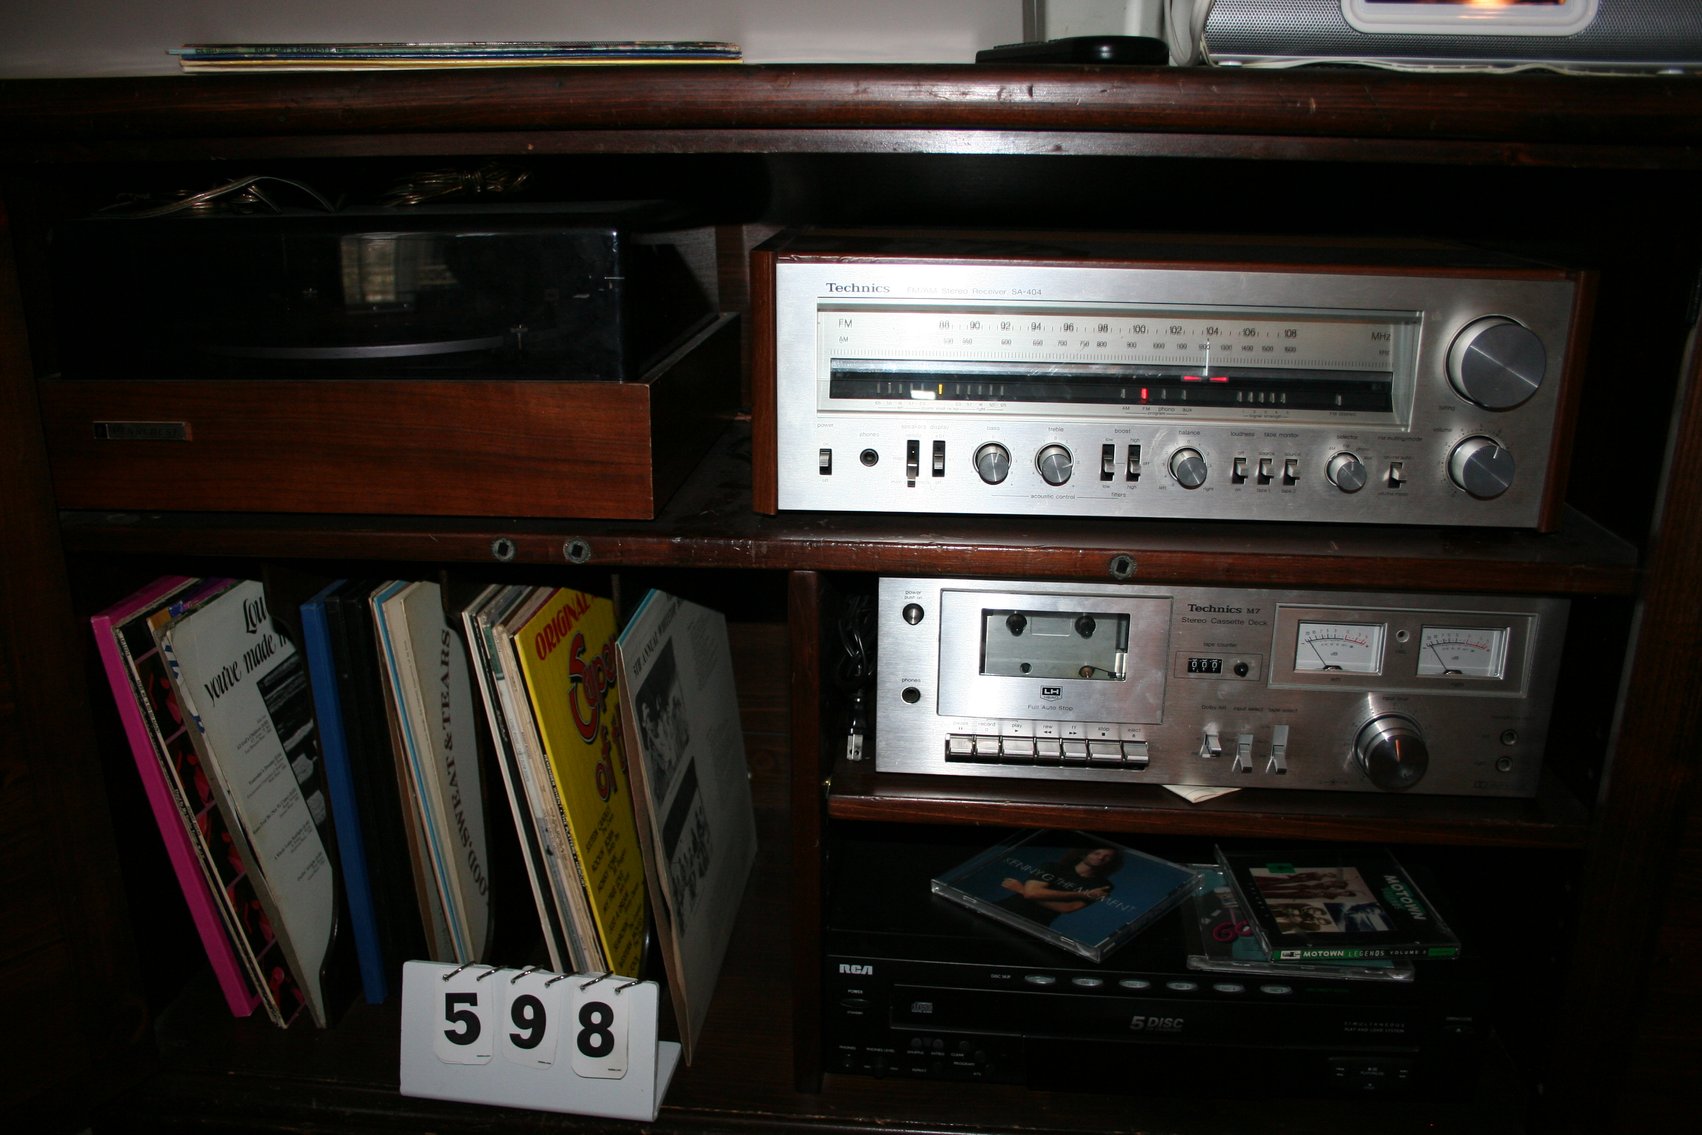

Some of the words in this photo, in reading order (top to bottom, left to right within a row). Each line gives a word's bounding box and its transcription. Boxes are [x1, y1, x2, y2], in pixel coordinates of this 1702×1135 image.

[825, 282, 890, 294] Technics
[941, 287, 968, 295] Stereo
[972, 288, 1007, 296] Receiver
[1011, 288, 1042, 296] SA-404
[838, 318, 852, 328] FM
[969, 321, 980, 330] 90
[1000, 321, 1011, 331] 92
[1030, 322, 1042, 331] 94
[1063, 322, 1074, 332] 96
[1098, 323, 1109, 333] 98
[1133, 325, 1146, 335] 100
[1169, 326, 1182, 335] 102
[1206, 326, 1219, 336] 104
[1242, 327, 1256, 337] 106
[1284, 328, 1297, 338] 108
[1371, 332, 1391, 341] MHz
[859, 431, 880, 439] phones
[243, 596, 267, 634] Lou
[1188, 604, 1242, 615] Technics
[1181, 616, 1208, 624] Stereo
[1210, 617, 1245, 626] Cassette
[1248, 618, 1268, 626] Deck
[243, 633, 277, 674] made
[1191, 661, 1218, 669] 000
[440, 628, 451, 730] TEARS
[443, 731, 453, 752] &
[445, 755, 470, 848] SWEAT
[1005, 857, 1045, 875] KENNY
[1042, 873, 1056, 882] G
[1384, 875, 1427, 920] MOTOWN
[839, 963, 874, 976] RCA
[1130, 1016, 1145, 1030] 5
[1148, 1016, 1184, 1029] DISC
